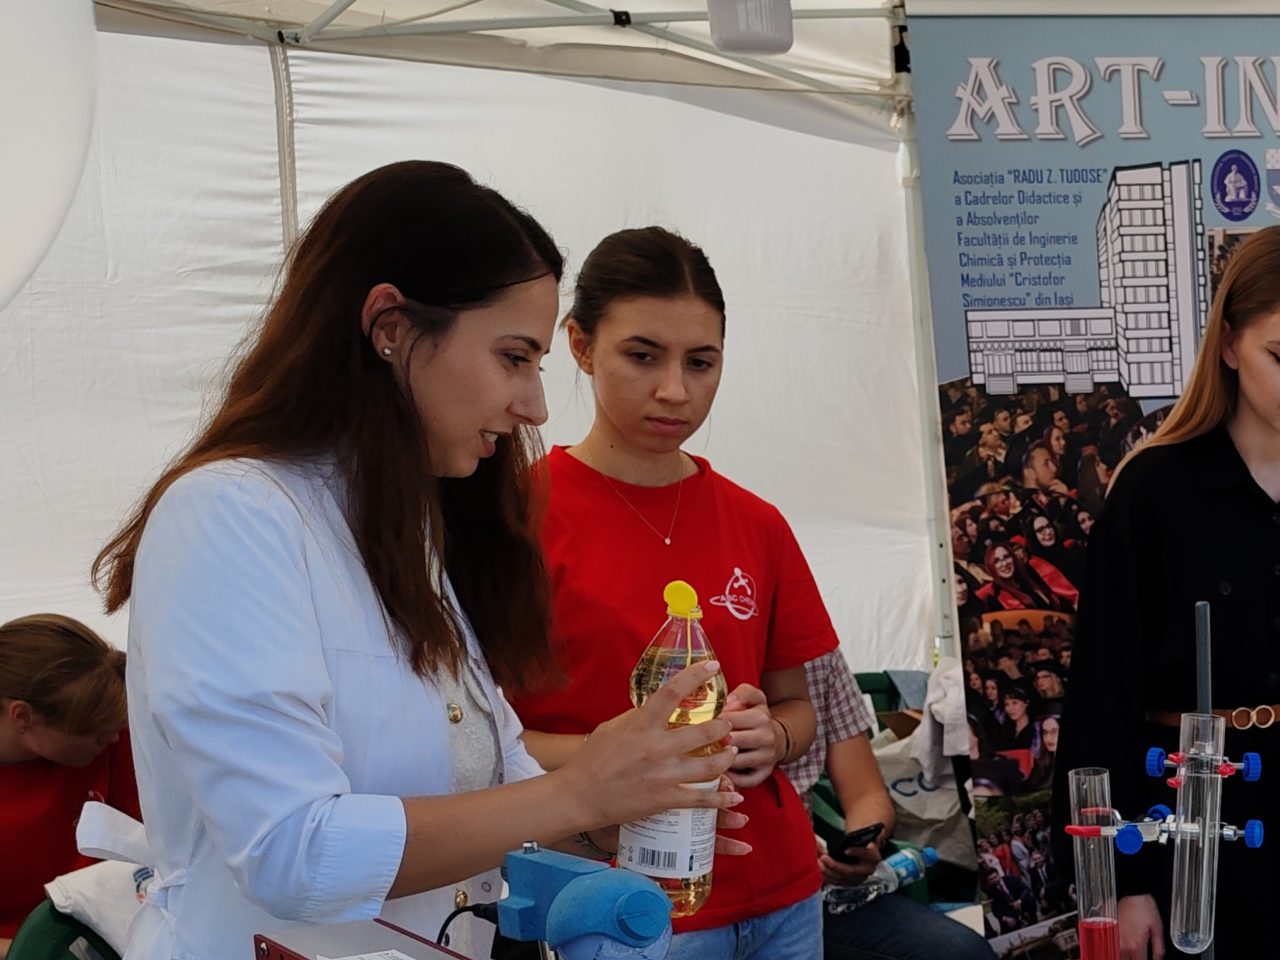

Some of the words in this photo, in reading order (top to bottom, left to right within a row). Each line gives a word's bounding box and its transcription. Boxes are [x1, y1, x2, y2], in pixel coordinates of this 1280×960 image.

[953, 171, 1004, 188] Asociația
[955, 195, 961, 205] a
[965, 191, 1014, 205] Cadrelor
[1018, 190, 1069, 204] Didactice
[956, 216, 962, 225] a
[967, 211, 1040, 228] Absolvenților
[958, 232, 1009, 248] Facultății
[1013, 232, 1026, 245] de
[1029, 232, 1078, 248] Inginerie
[959, 253, 1004, 267] Chimică
[1020, 252, 1071, 270] Protecția
[961, 273, 1006, 287] Mediului
[1009, 272, 1065, 286] "Cristofor
[962, 292, 1031, 308] Simionescu"
[1035, 293, 1051, 305] din
